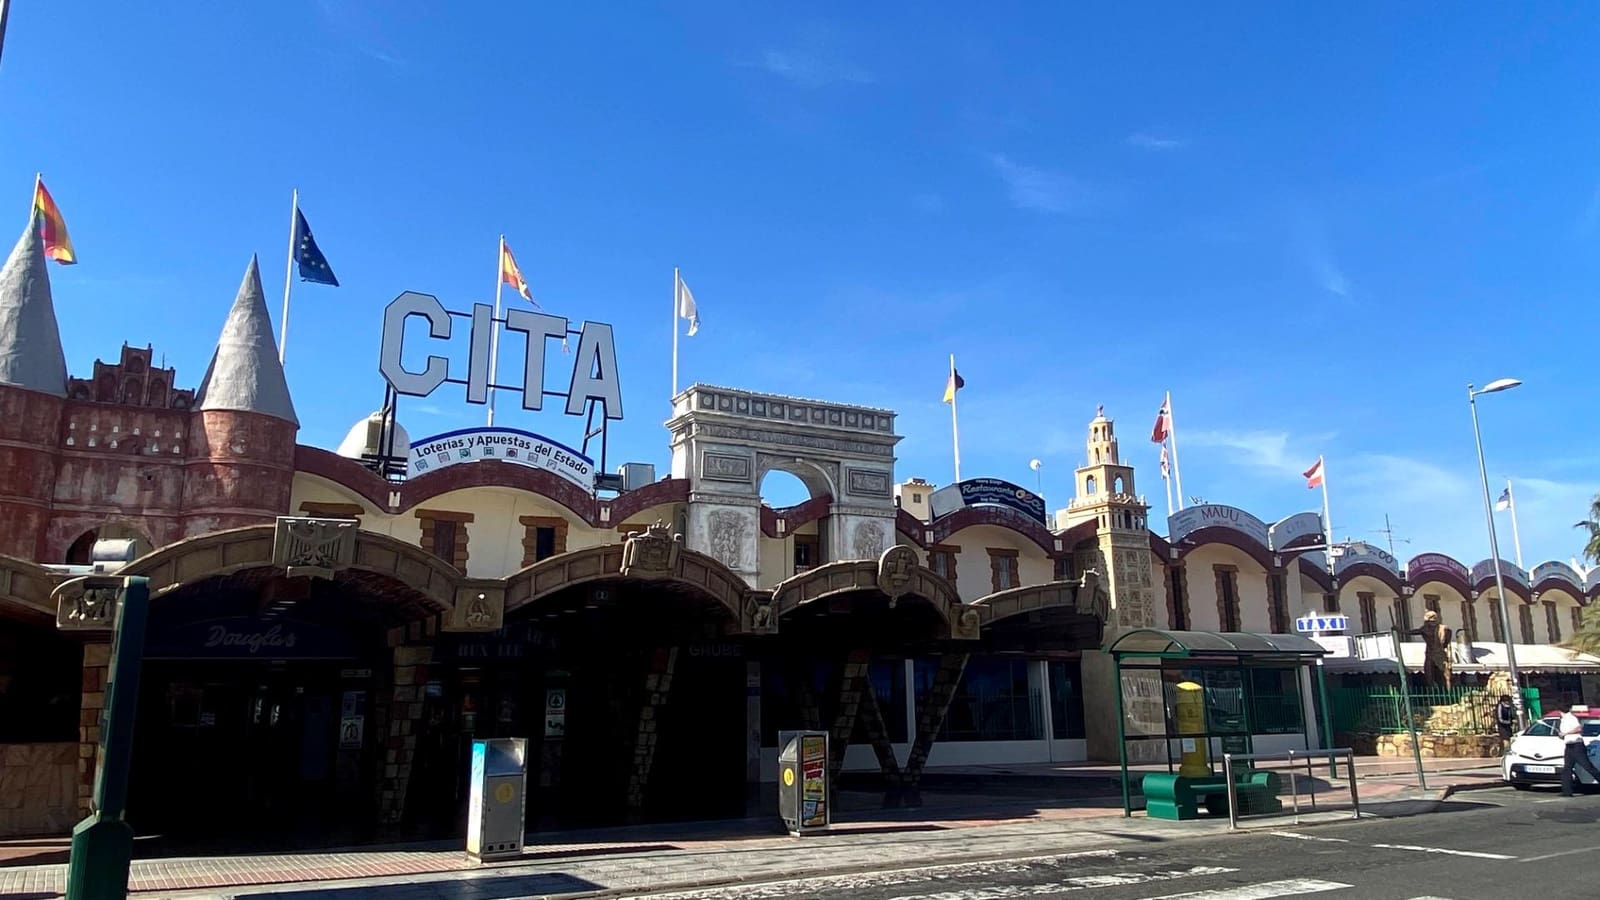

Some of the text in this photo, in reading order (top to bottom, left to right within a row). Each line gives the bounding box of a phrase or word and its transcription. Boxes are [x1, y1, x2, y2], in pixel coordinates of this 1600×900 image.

[379, 290, 623, 420] CITA
[467, 437, 475, 448] y
[476, 435, 531, 450] Apuestas
[534, 443, 552, 457] del
[554, 450, 588, 475] Estado
[1200, 506, 1240, 522] MAUU
[203, 623, 297, 653] Douglas
[1300, 617, 1342, 630] TAXI
